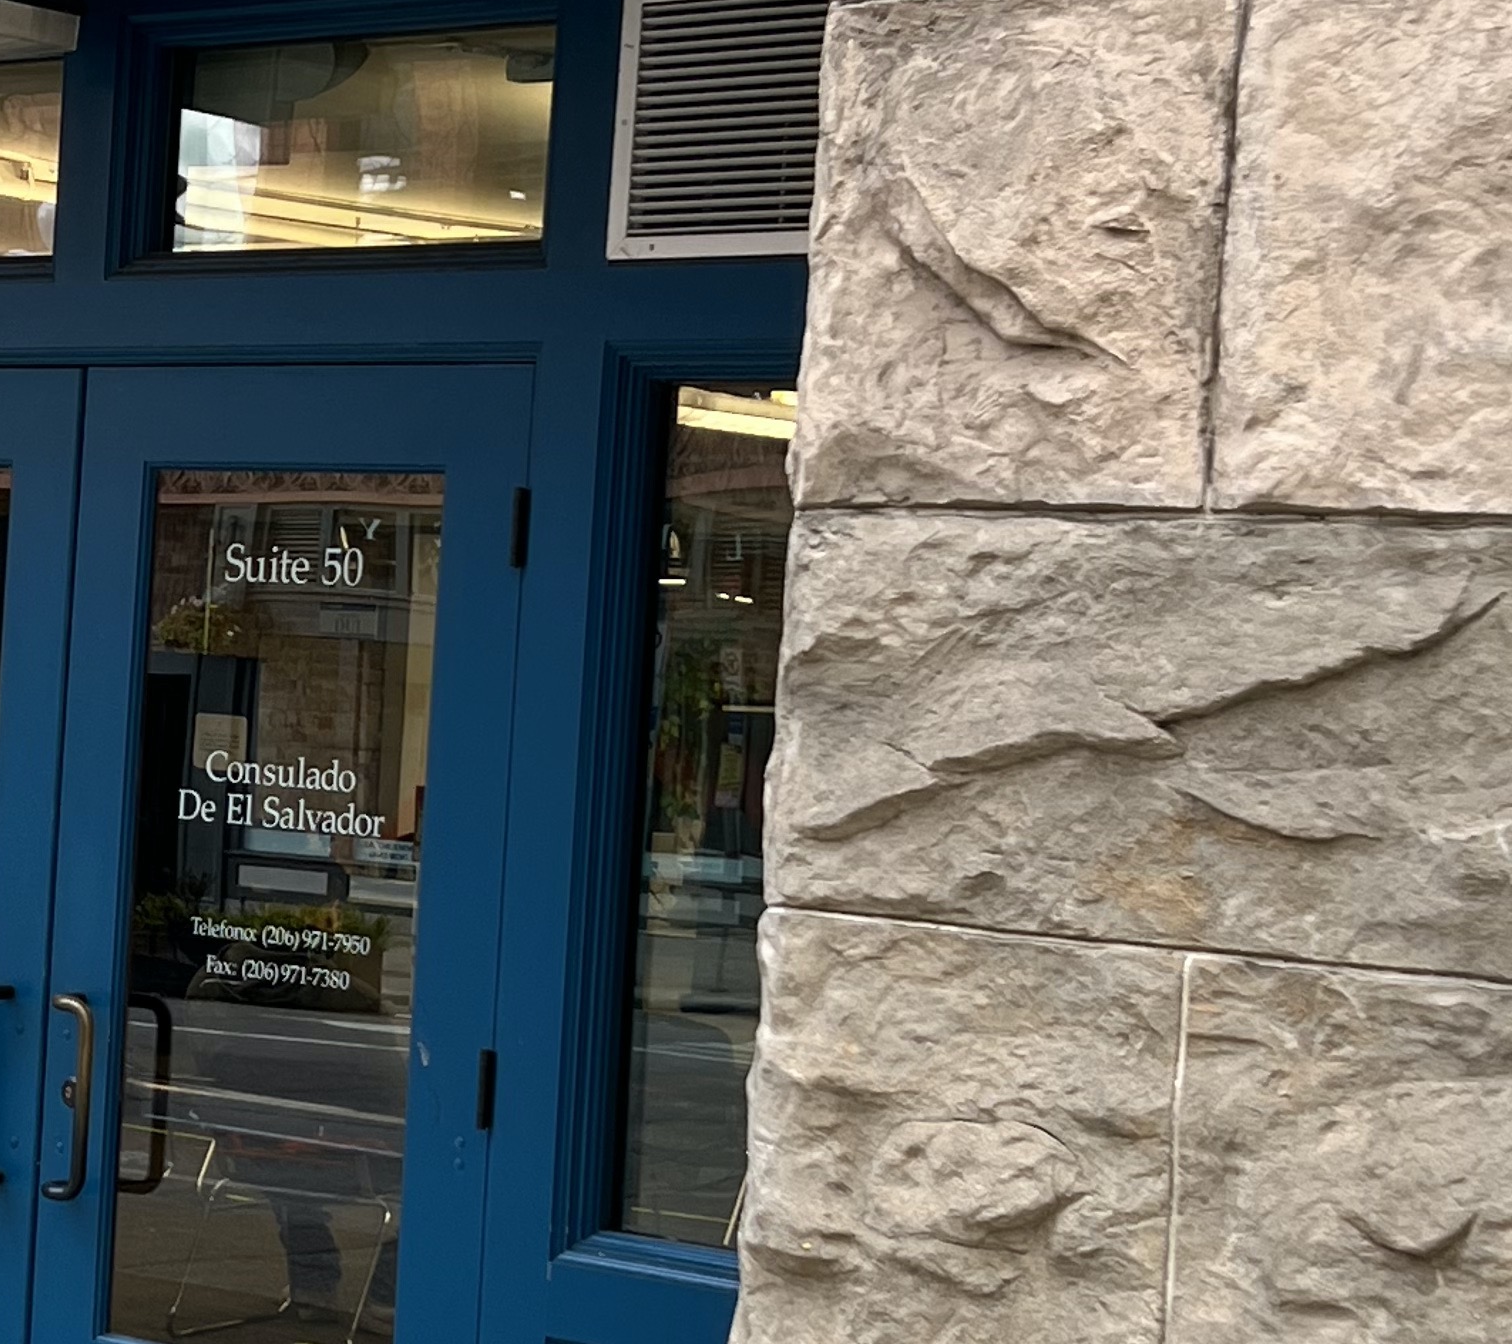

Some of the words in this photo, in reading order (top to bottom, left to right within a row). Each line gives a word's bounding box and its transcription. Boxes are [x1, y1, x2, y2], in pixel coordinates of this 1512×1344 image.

[224, 542, 310, 585] Suite
[321, 547, 364, 587] 50
[205, 749, 356, 793] Consulado
[177, 788, 217, 822] De
[226, 792, 253, 826] El
[261, 795, 386, 838] Salvador
[261, 925, 300, 951] (206)
[301, 929, 371, 956] 971-7950
[205, 954, 237, 976] Fax:
[241, 959, 279, 985] (206)
[281, 964, 350, 990] 971-7380
